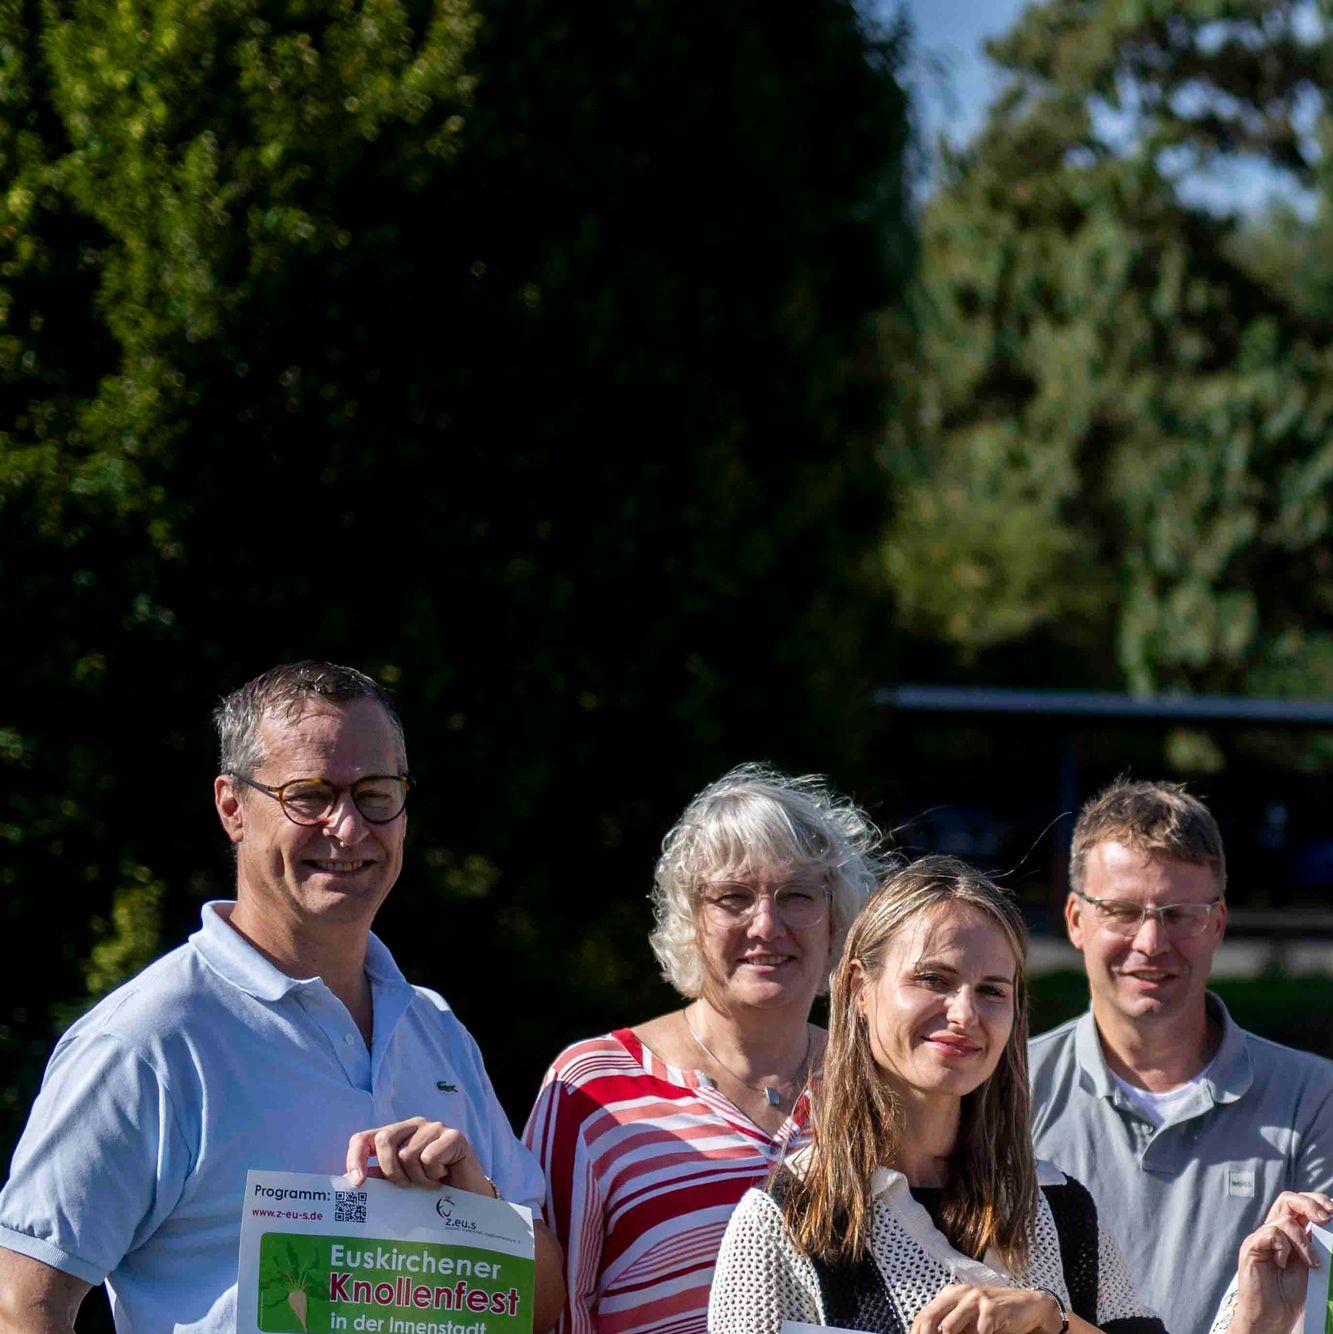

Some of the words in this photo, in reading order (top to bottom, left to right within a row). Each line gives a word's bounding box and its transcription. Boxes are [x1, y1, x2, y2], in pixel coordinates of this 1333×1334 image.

[255, 1184, 331, 1201] Programm:
[252, 1209, 323, 1220] www.z-eu-s.de
[445, 1217, 475, 1230] z.eu.s
[331, 1244, 502, 1281] Euskirchener
[329, 1270, 522, 1318] Knollenfest
[330, 1312, 346, 1329] in
[353, 1313, 382, 1332] der
